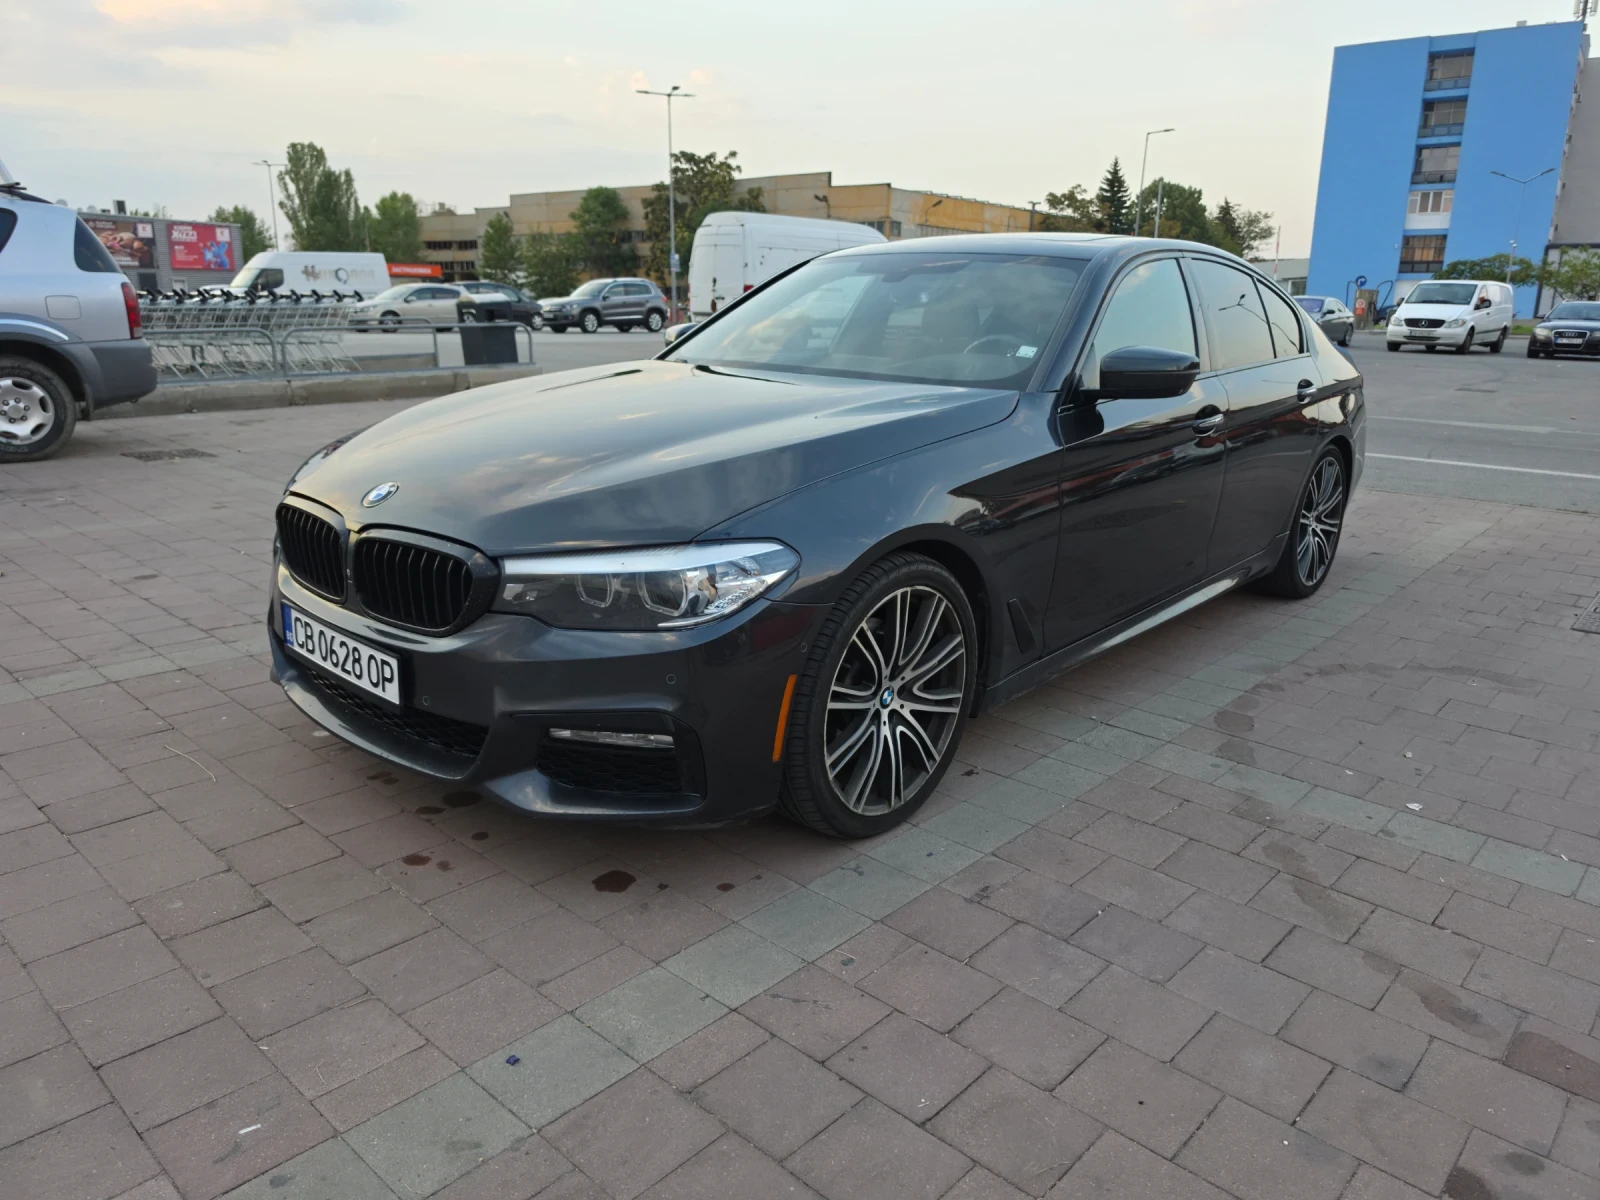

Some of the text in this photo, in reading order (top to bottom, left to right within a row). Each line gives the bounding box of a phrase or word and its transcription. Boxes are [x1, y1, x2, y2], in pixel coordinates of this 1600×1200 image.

[294, 616, 394, 693] CB 0628 OP
